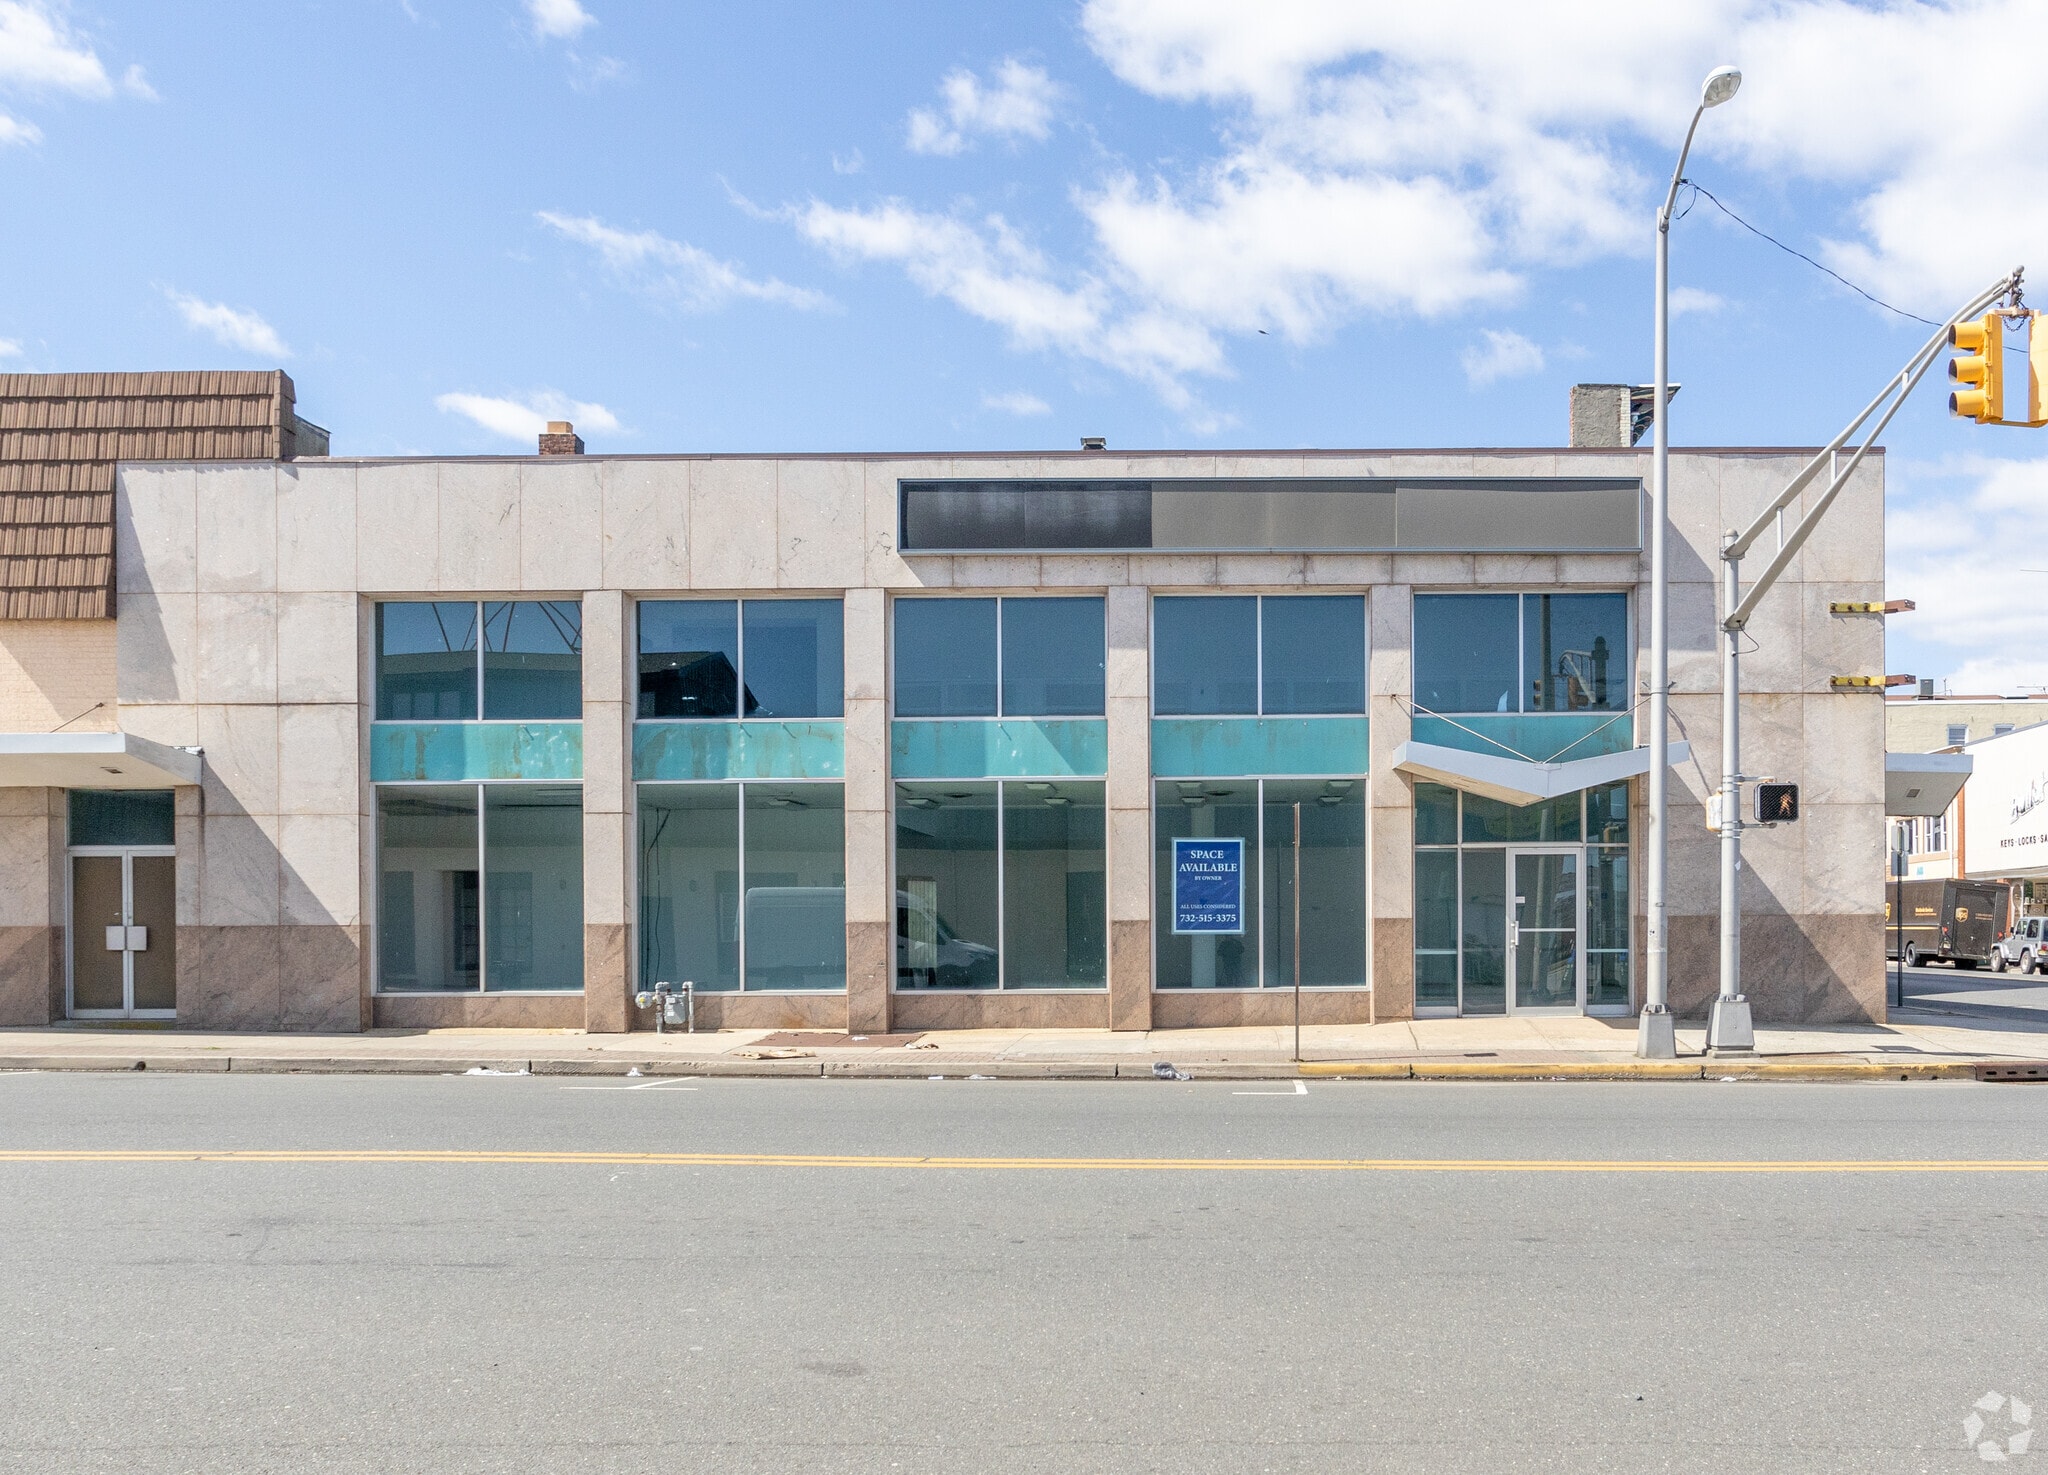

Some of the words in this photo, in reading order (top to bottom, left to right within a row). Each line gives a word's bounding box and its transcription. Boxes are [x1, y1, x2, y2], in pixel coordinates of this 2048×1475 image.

[2000, 838, 2014, 848] KEYS
[2017, 835, 2036, 846] LOCKS
[1190, 850, 1224, 859] SPACE
[1179, 863, 1238, 872] AVAILABLE
[1180, 914, 1237, 922] 732-515-3375
